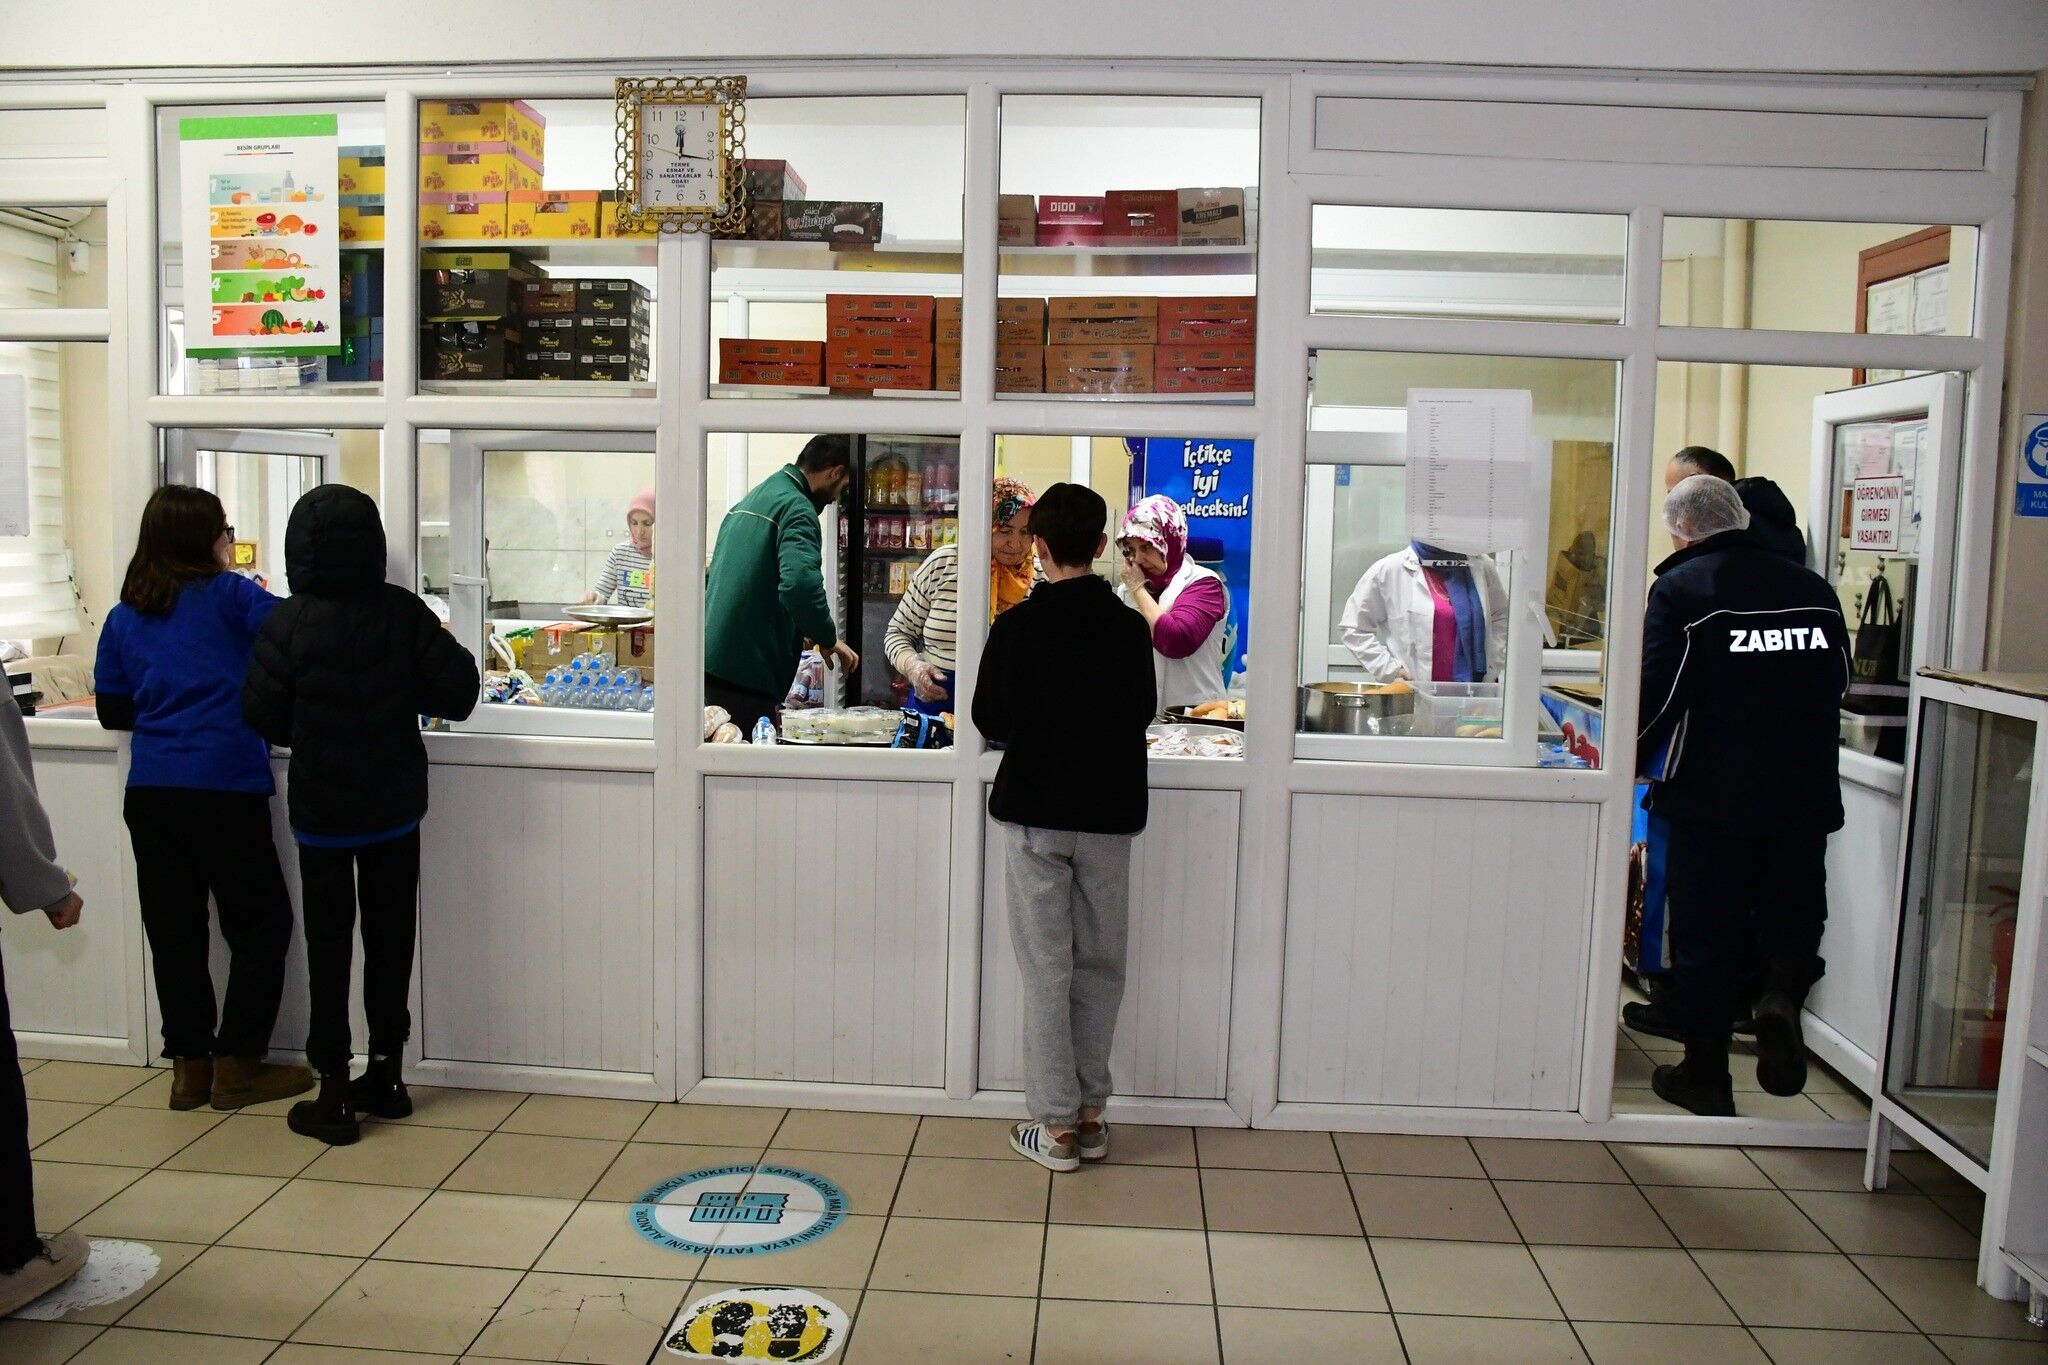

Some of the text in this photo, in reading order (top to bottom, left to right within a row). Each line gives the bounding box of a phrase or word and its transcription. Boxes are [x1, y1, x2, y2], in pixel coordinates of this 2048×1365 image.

[652, 111, 662, 122] 11
[675, 110, 687, 122] 12
[647, 133, 660, 145] 10
[706, 131, 715, 143] 2
[646, 150, 653, 162] 9
[707, 149, 715, 161] 3
[646, 169, 654, 180] 8
[706, 167, 714, 179] 4
[654, 190, 662, 201] 7
[676, 189, 684, 201] 6
[698, 190, 706, 201] 5
[2033, 490, 2048, 499] MA
[1181, 494, 1249, 517] edeceksin!
[1729, 627, 1829, 653] ZABITA
[765, 1167, 804, 1179] SATIN
[664, 1239, 754, 1255] FATURASINI
